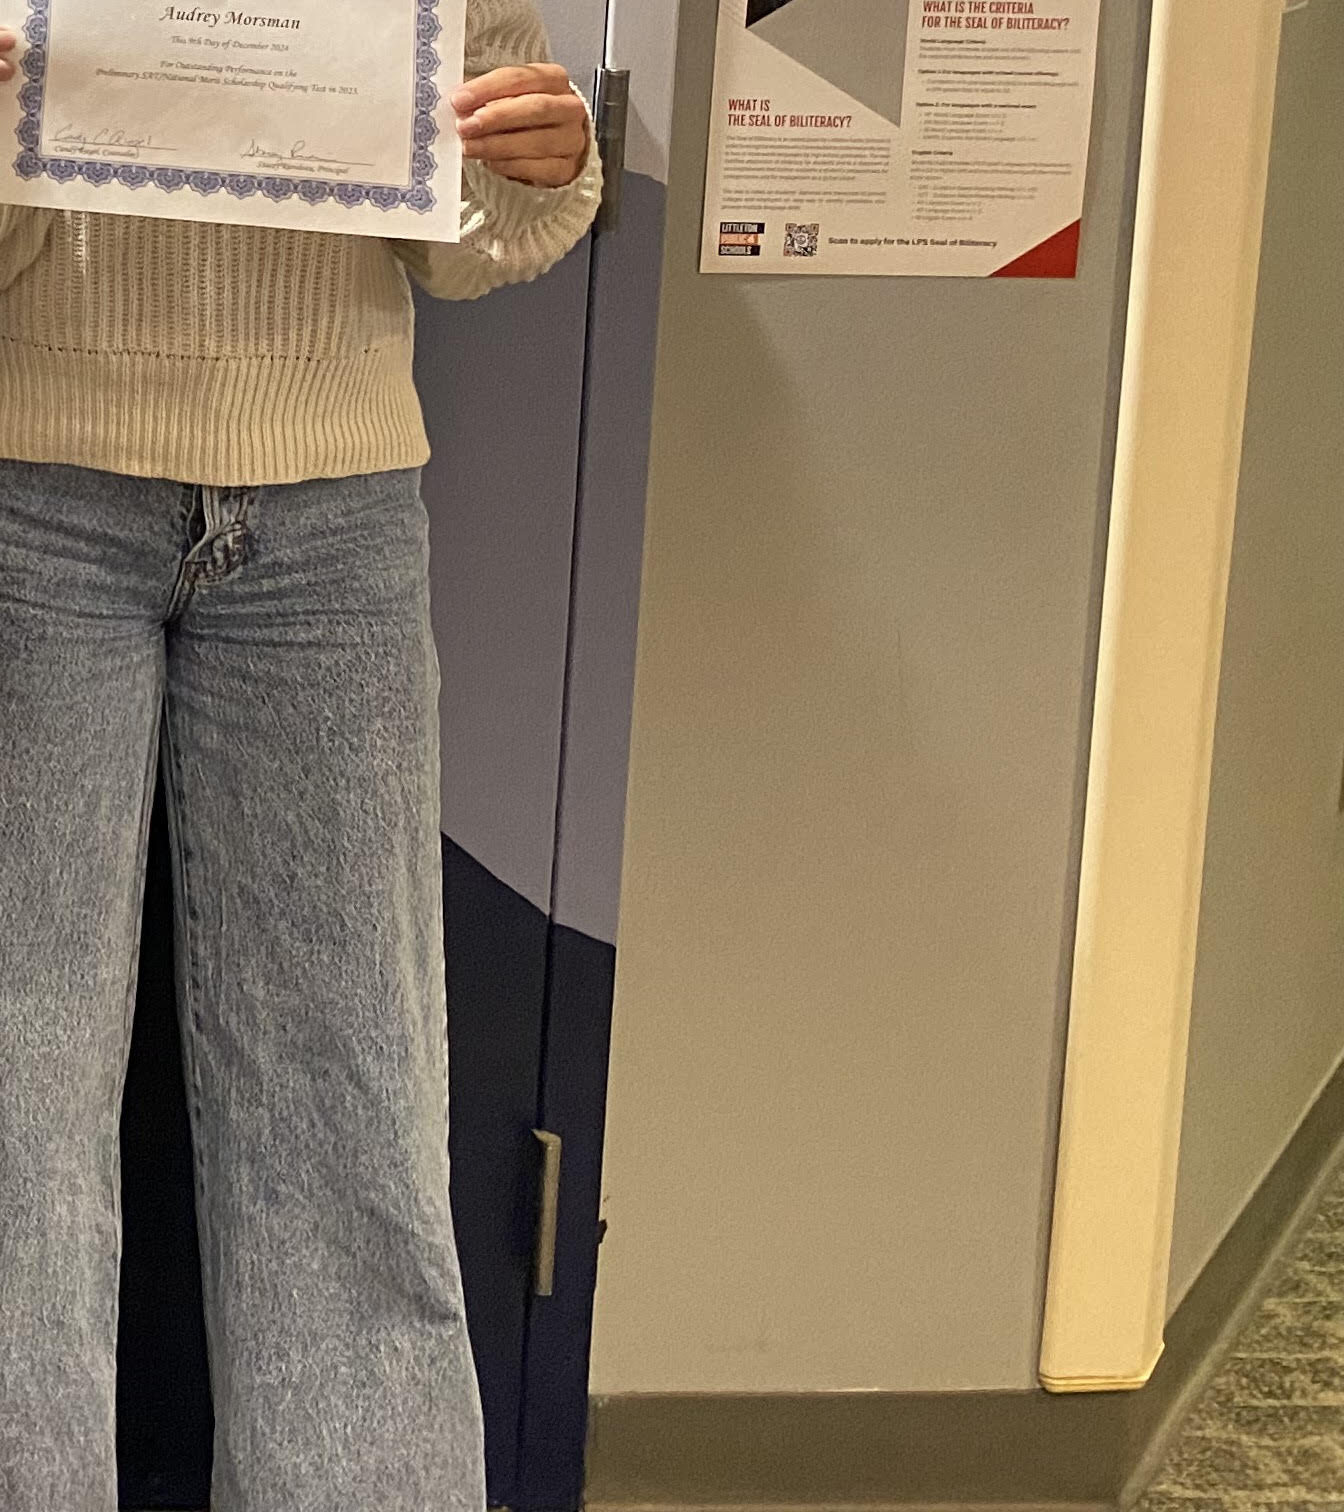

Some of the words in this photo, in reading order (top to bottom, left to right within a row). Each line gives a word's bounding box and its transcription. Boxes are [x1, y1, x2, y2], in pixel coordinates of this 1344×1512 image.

[922, 1, 953, 12] WHAT
[955, 1, 965, 13] IS
[968, 2, 987, 13] THE
[989, 2, 1035, 14] CRITERIA
[159, 6, 220, 27] Audrey
[225, 11, 301, 29] Morsman
[921, 16, 941, 27] FOR
[944, 16, 962, 28] THE
[965, 17, 988, 29] SEAL
[991, 17, 1004, 29] OF
[1007, 18, 1070, 30] BILITERACY?
[728, 100, 757, 111] WHAT
[760, 100, 770, 111] IS
[728, 115, 745, 126] THE
[748, 115, 770, 126] SEAL
[774, 115, 787, 126] OF
[790, 116, 852, 128] BILITERACY?
[860, 239, 882, 247] apply
[959, 240, 997, 249] Biliteracy
